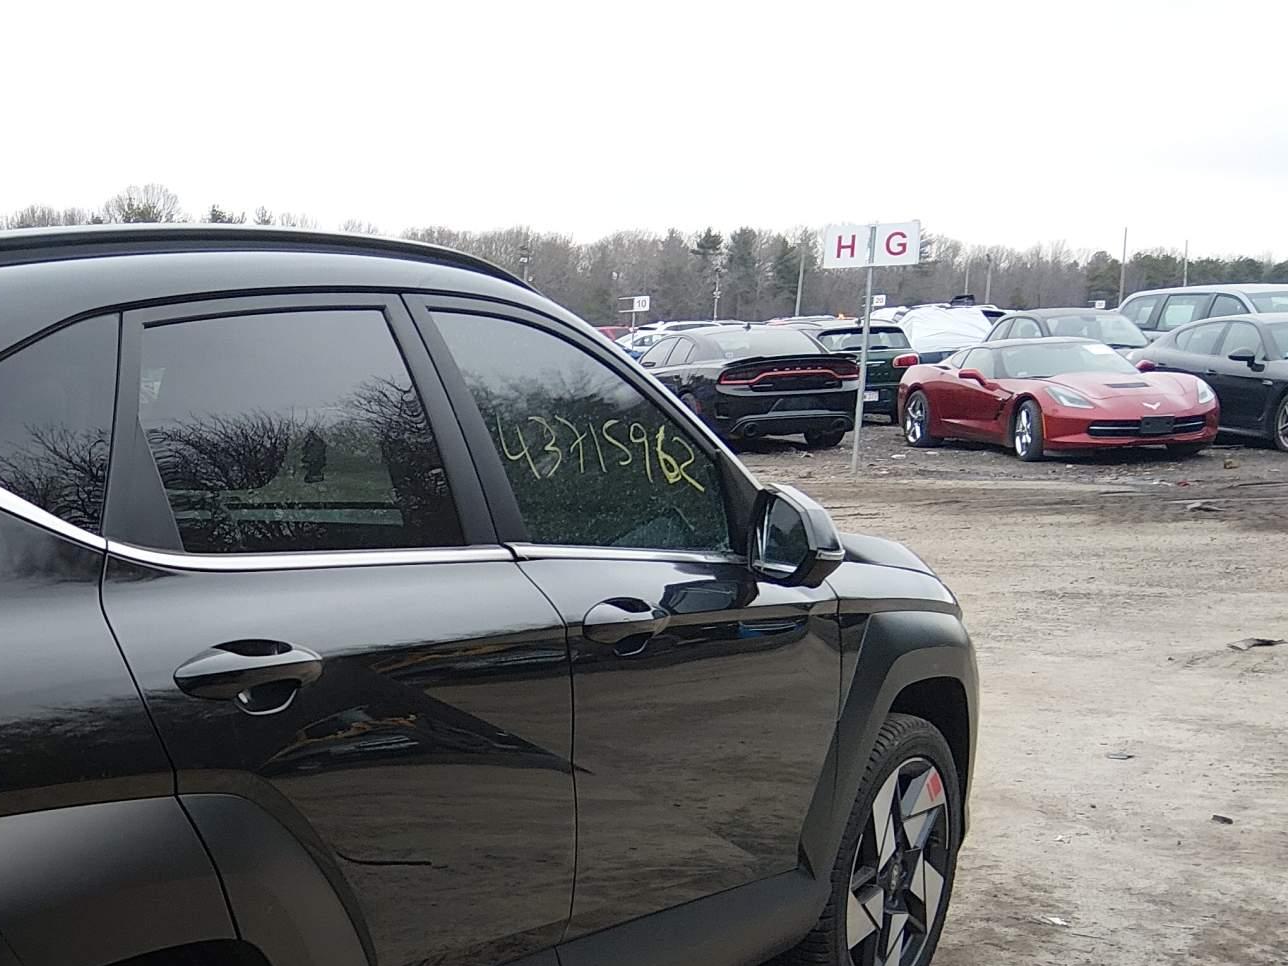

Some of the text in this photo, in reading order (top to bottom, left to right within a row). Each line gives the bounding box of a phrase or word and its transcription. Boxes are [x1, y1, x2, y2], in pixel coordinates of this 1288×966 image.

[836, 234, 856, 258] H
[885, 231, 907, 256] G
[637, 299, 647, 308] 10
[497, 414, 705, 492] 43715962
